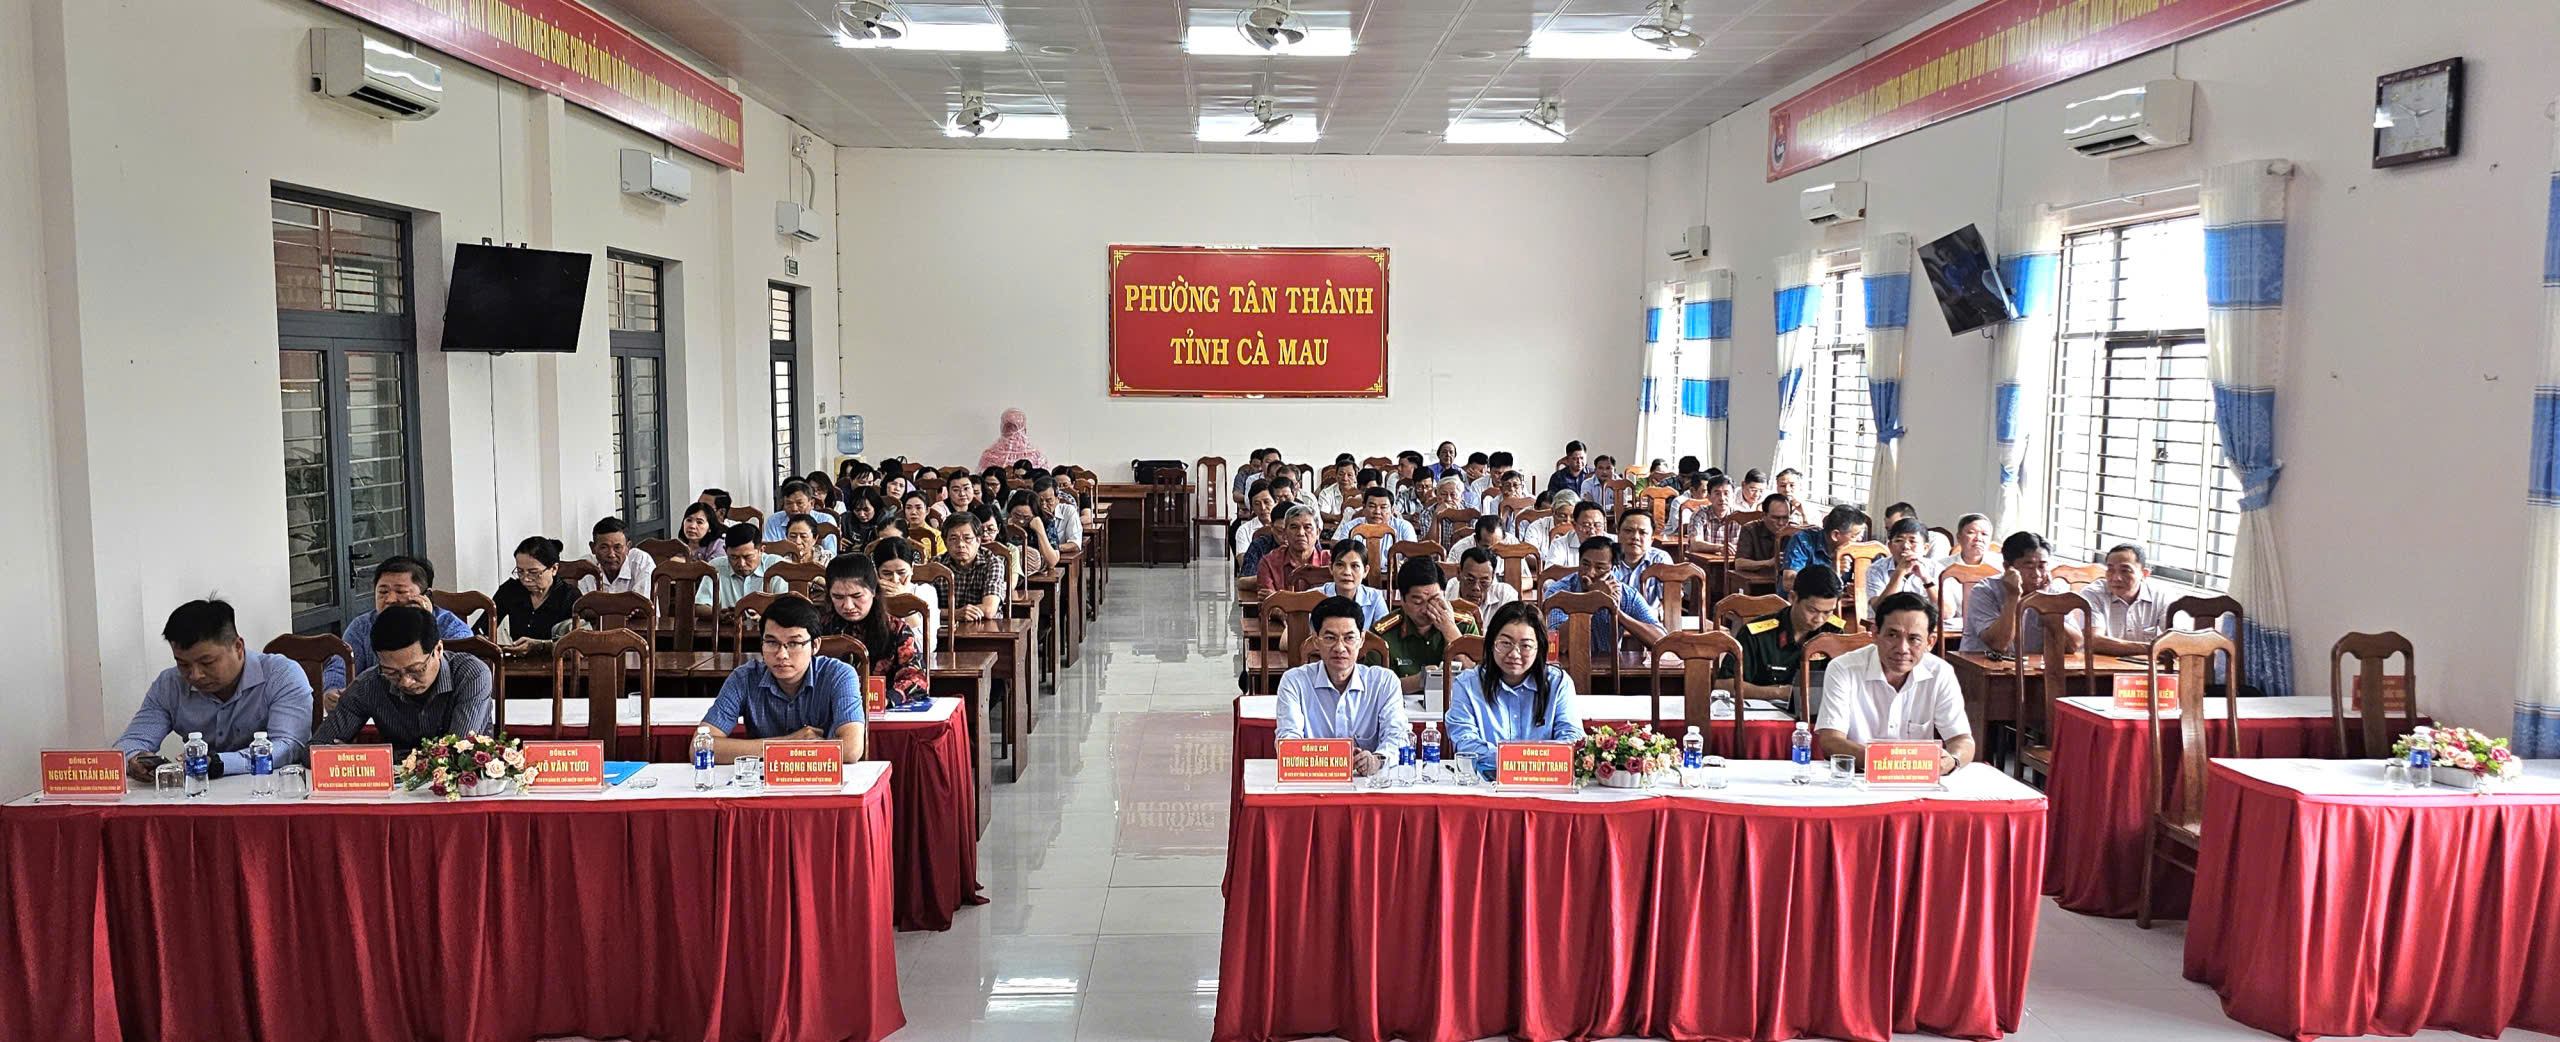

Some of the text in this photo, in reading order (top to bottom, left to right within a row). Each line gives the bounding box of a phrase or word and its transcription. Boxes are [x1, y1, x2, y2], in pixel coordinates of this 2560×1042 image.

[512, 3, 531, 53] TOÀN
[532, 13, 549, 67] DIỆN
[550, 20, 569, 69] CÔNG
[570, 32, 587, 83] CUỘC
[1124, 275, 1374, 314] PHƯỜNG TÂN THÀNH
[1170, 328, 1328, 365] TỈNH CÀ MAU
[550, 760, 568, 772] VĂN
[769, 760, 779, 772] LÊ
[780, 761, 805, 774] TRỌNG
[1329, 757, 1348, 767] KHOA
[1503, 760, 1516, 771] MAI
[1517, 760, 1528, 774] THỊ
[1546, 761, 1568, 772] TRANG
[48, 766, 77, 780] NGUYỄN
[341, 764, 355, 777] CHÍ
[356, 766, 376, 777] LINH
